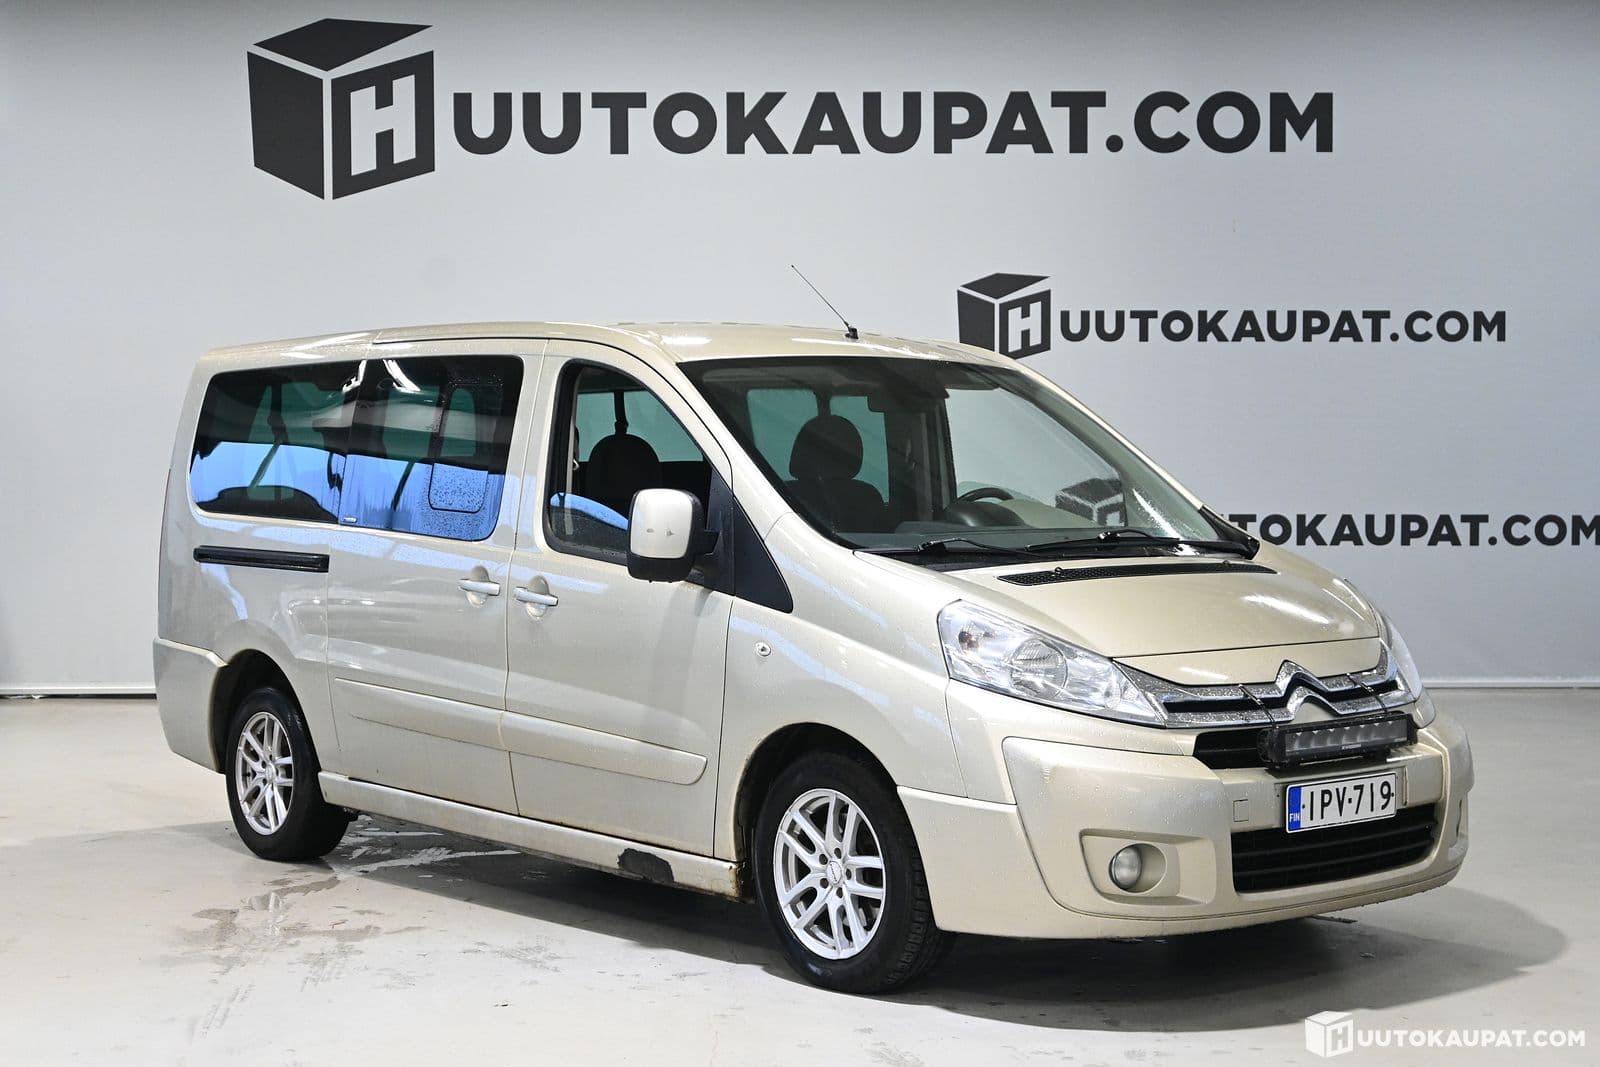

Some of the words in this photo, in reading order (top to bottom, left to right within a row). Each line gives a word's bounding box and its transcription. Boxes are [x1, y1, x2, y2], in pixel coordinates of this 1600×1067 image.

[1221, 513, 1600, 546] TOKAUPAT.COM
[1309, 780, 1392, 821] IPV-719
[1289, 812, 1301, 823] FIN
